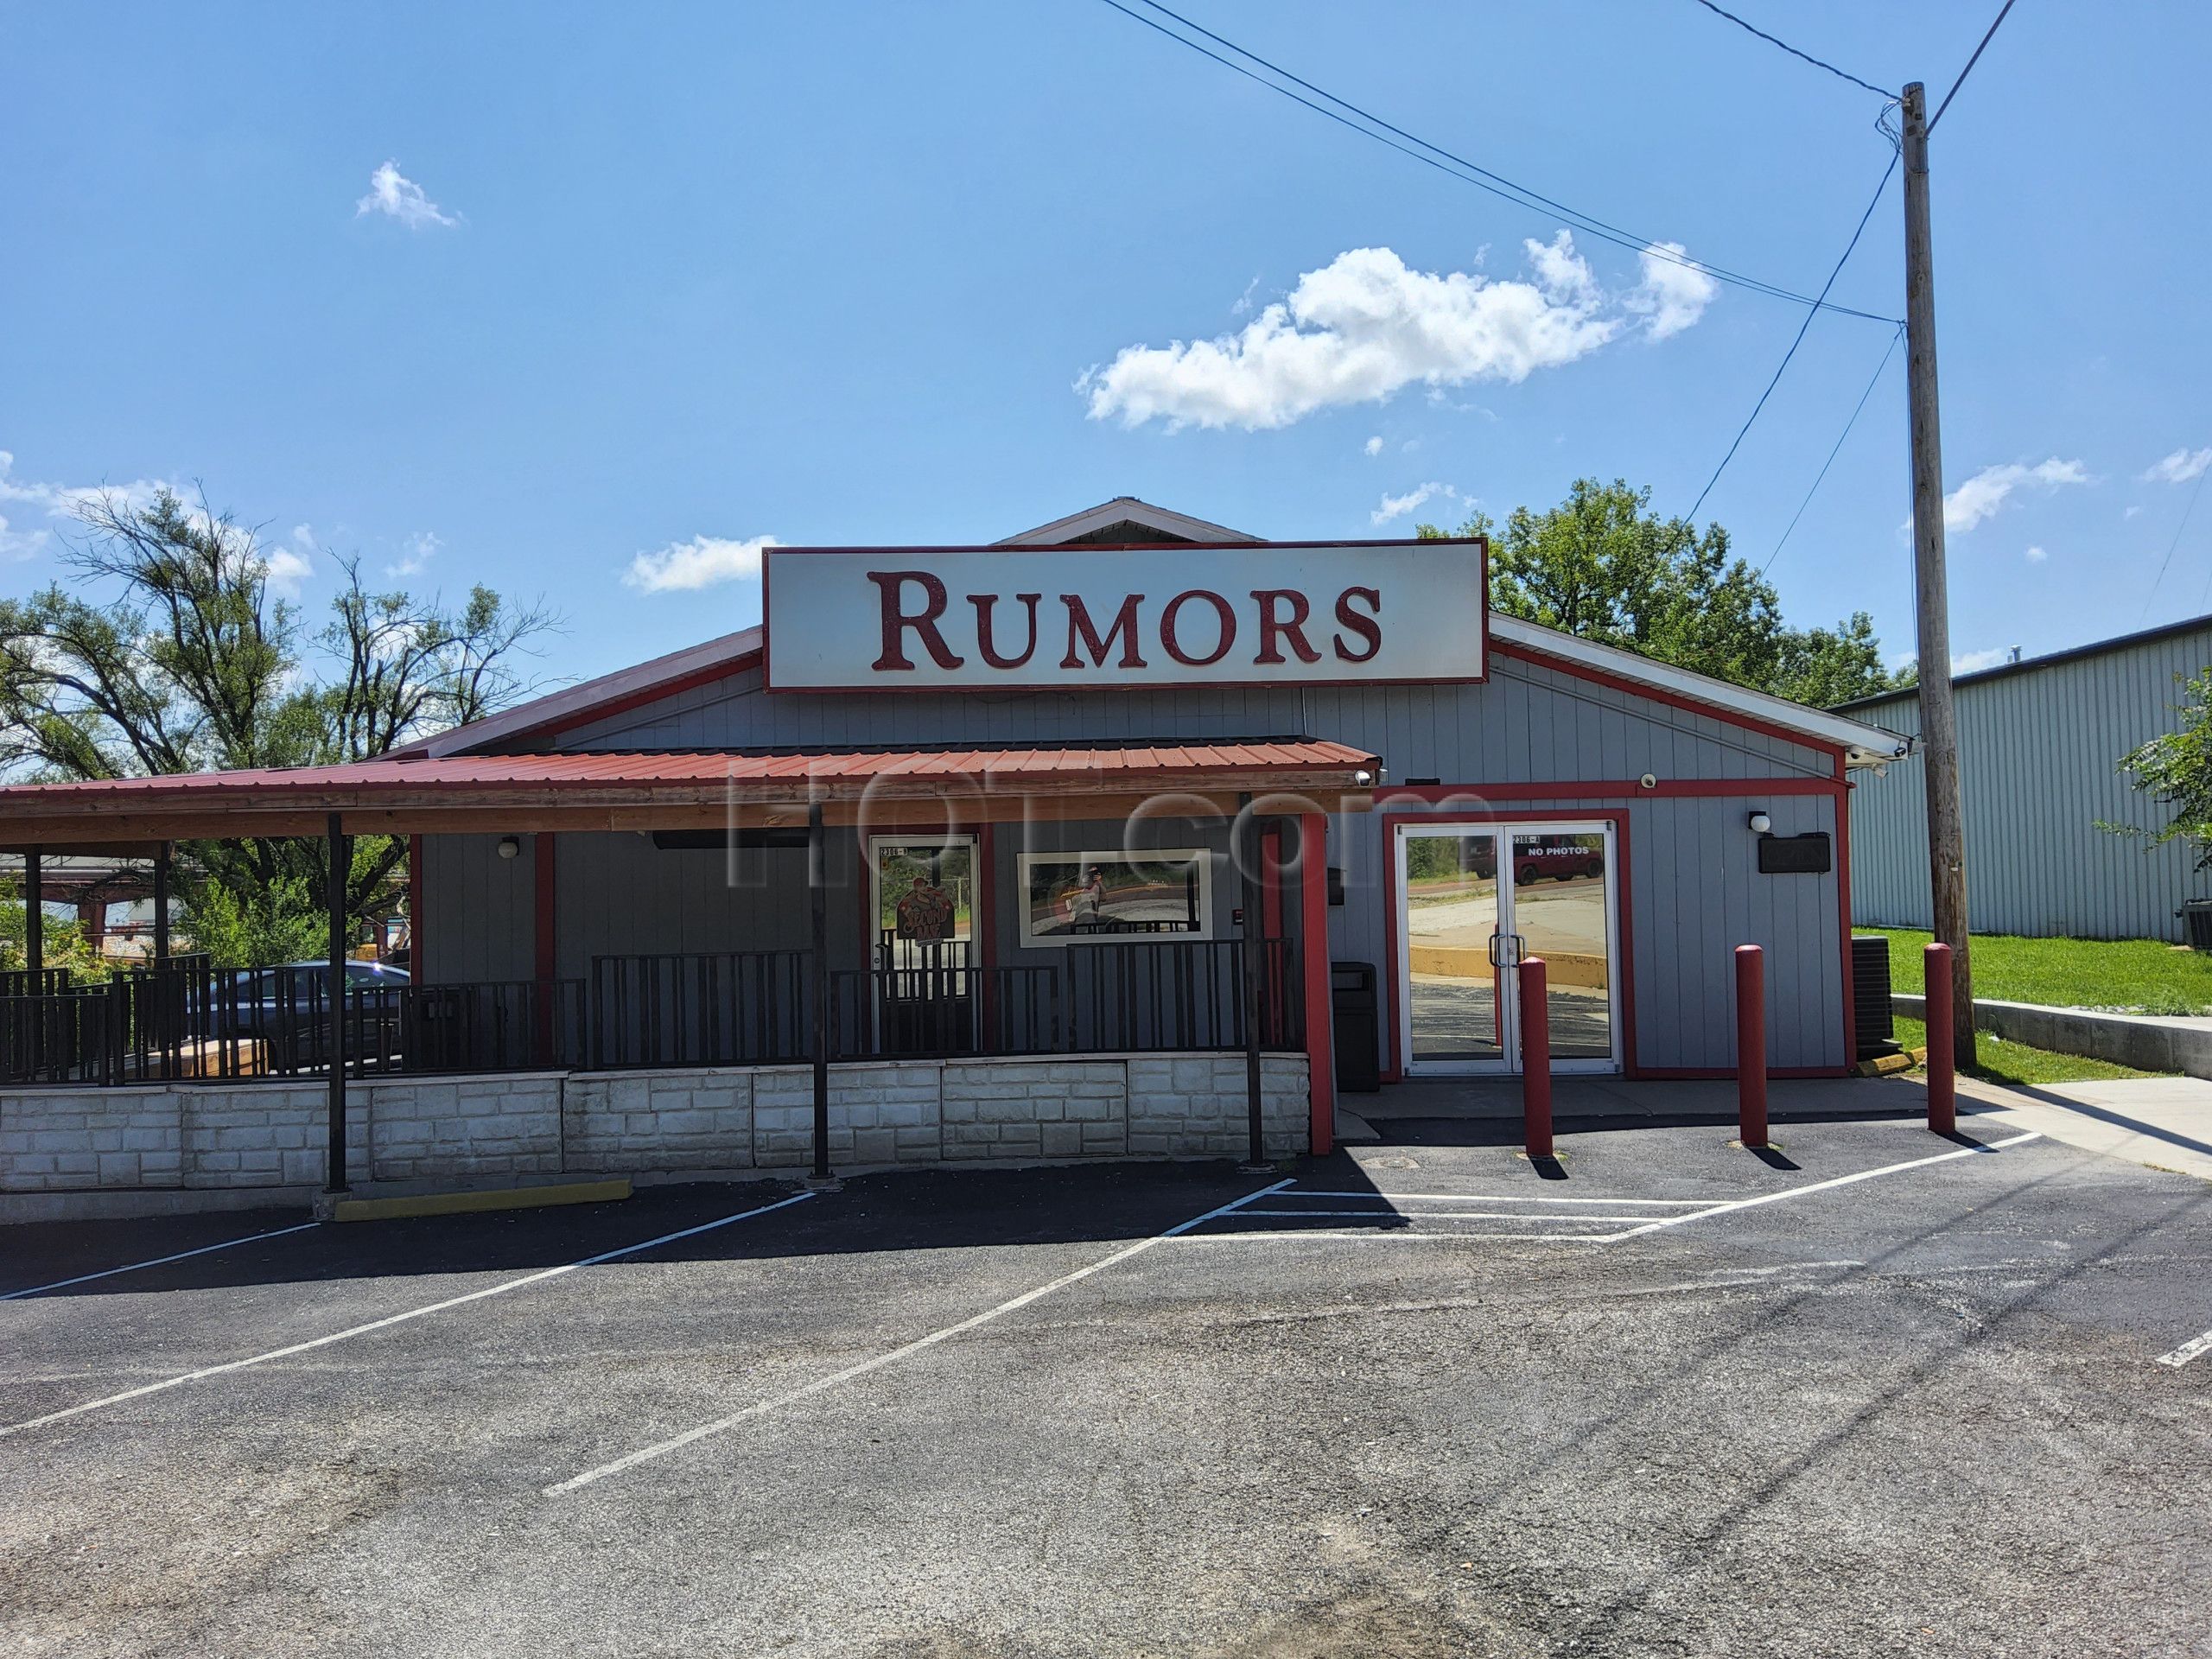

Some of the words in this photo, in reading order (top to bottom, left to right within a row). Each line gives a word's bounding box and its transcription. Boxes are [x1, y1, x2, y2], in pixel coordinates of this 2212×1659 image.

[867, 570, 1382, 671] RUMORS
[1528, 848, 1544, 856] NO
[1546, 846, 1590, 855] PHOTOS
